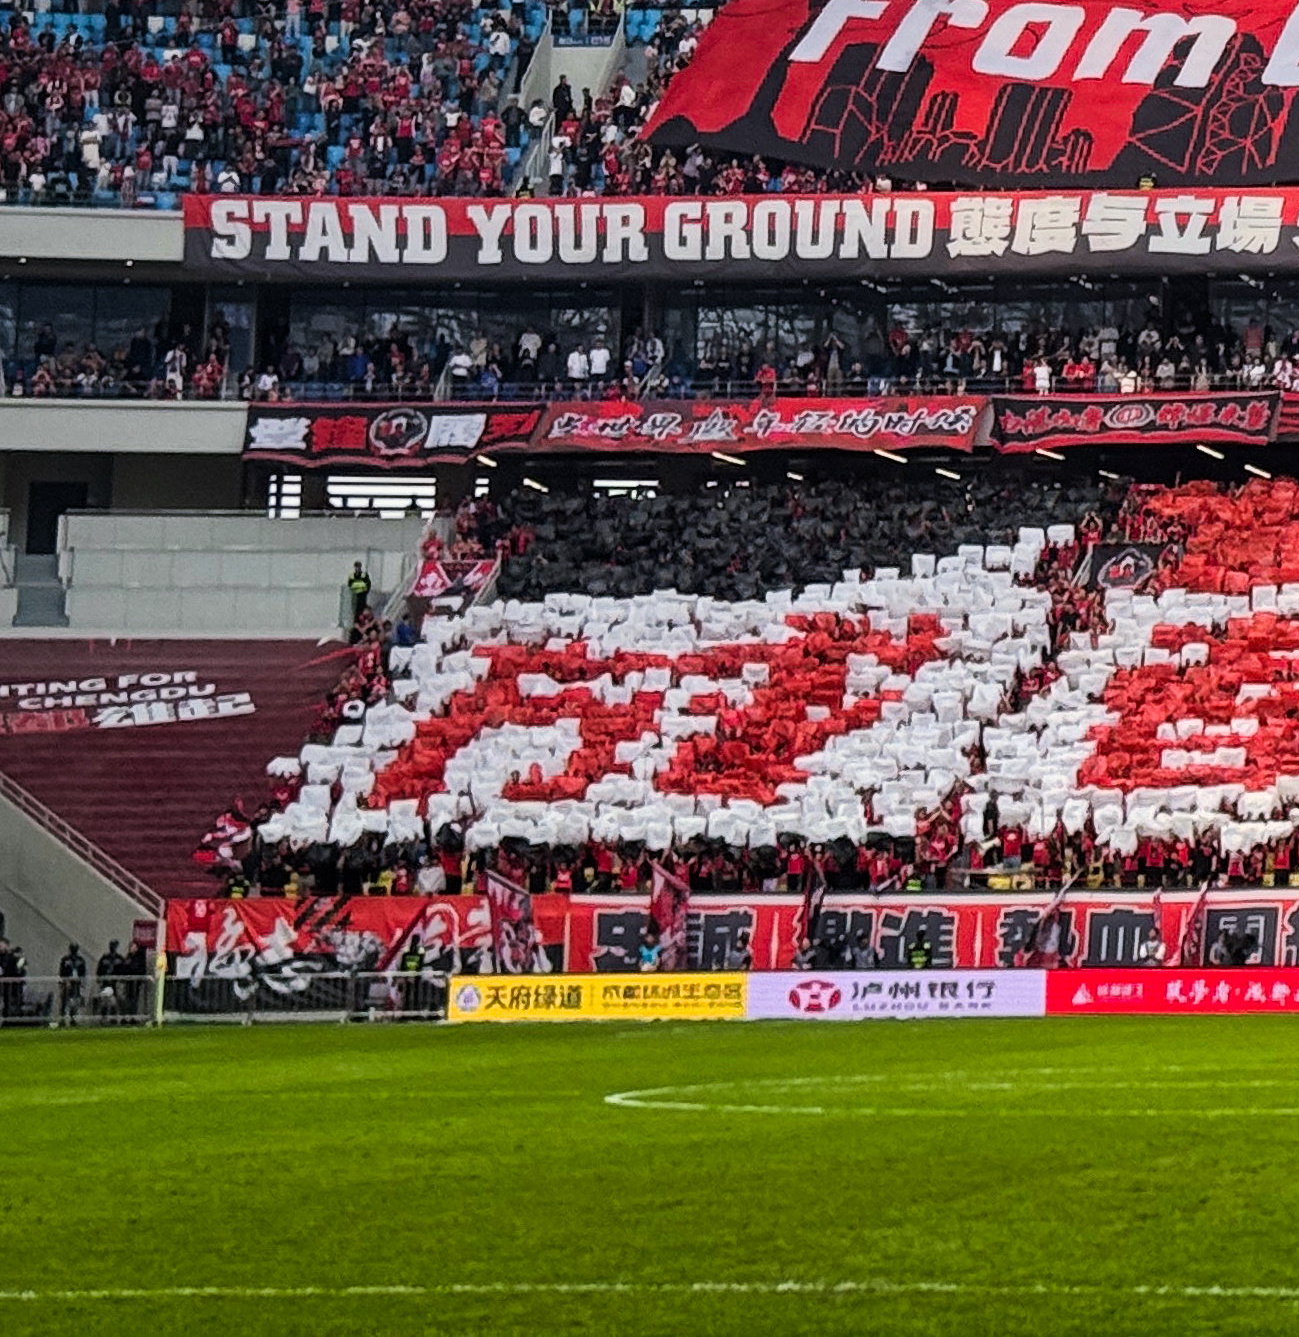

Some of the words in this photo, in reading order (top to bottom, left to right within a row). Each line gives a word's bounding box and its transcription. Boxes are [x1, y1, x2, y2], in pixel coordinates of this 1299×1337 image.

[210, 199, 447, 263] STAND
[467, 202, 649, 264] YOUR
[664, 198, 934, 261] GROUND
[118, 670, 198, 689] FOR
[18, 683, 216, 710] CHENGDU
